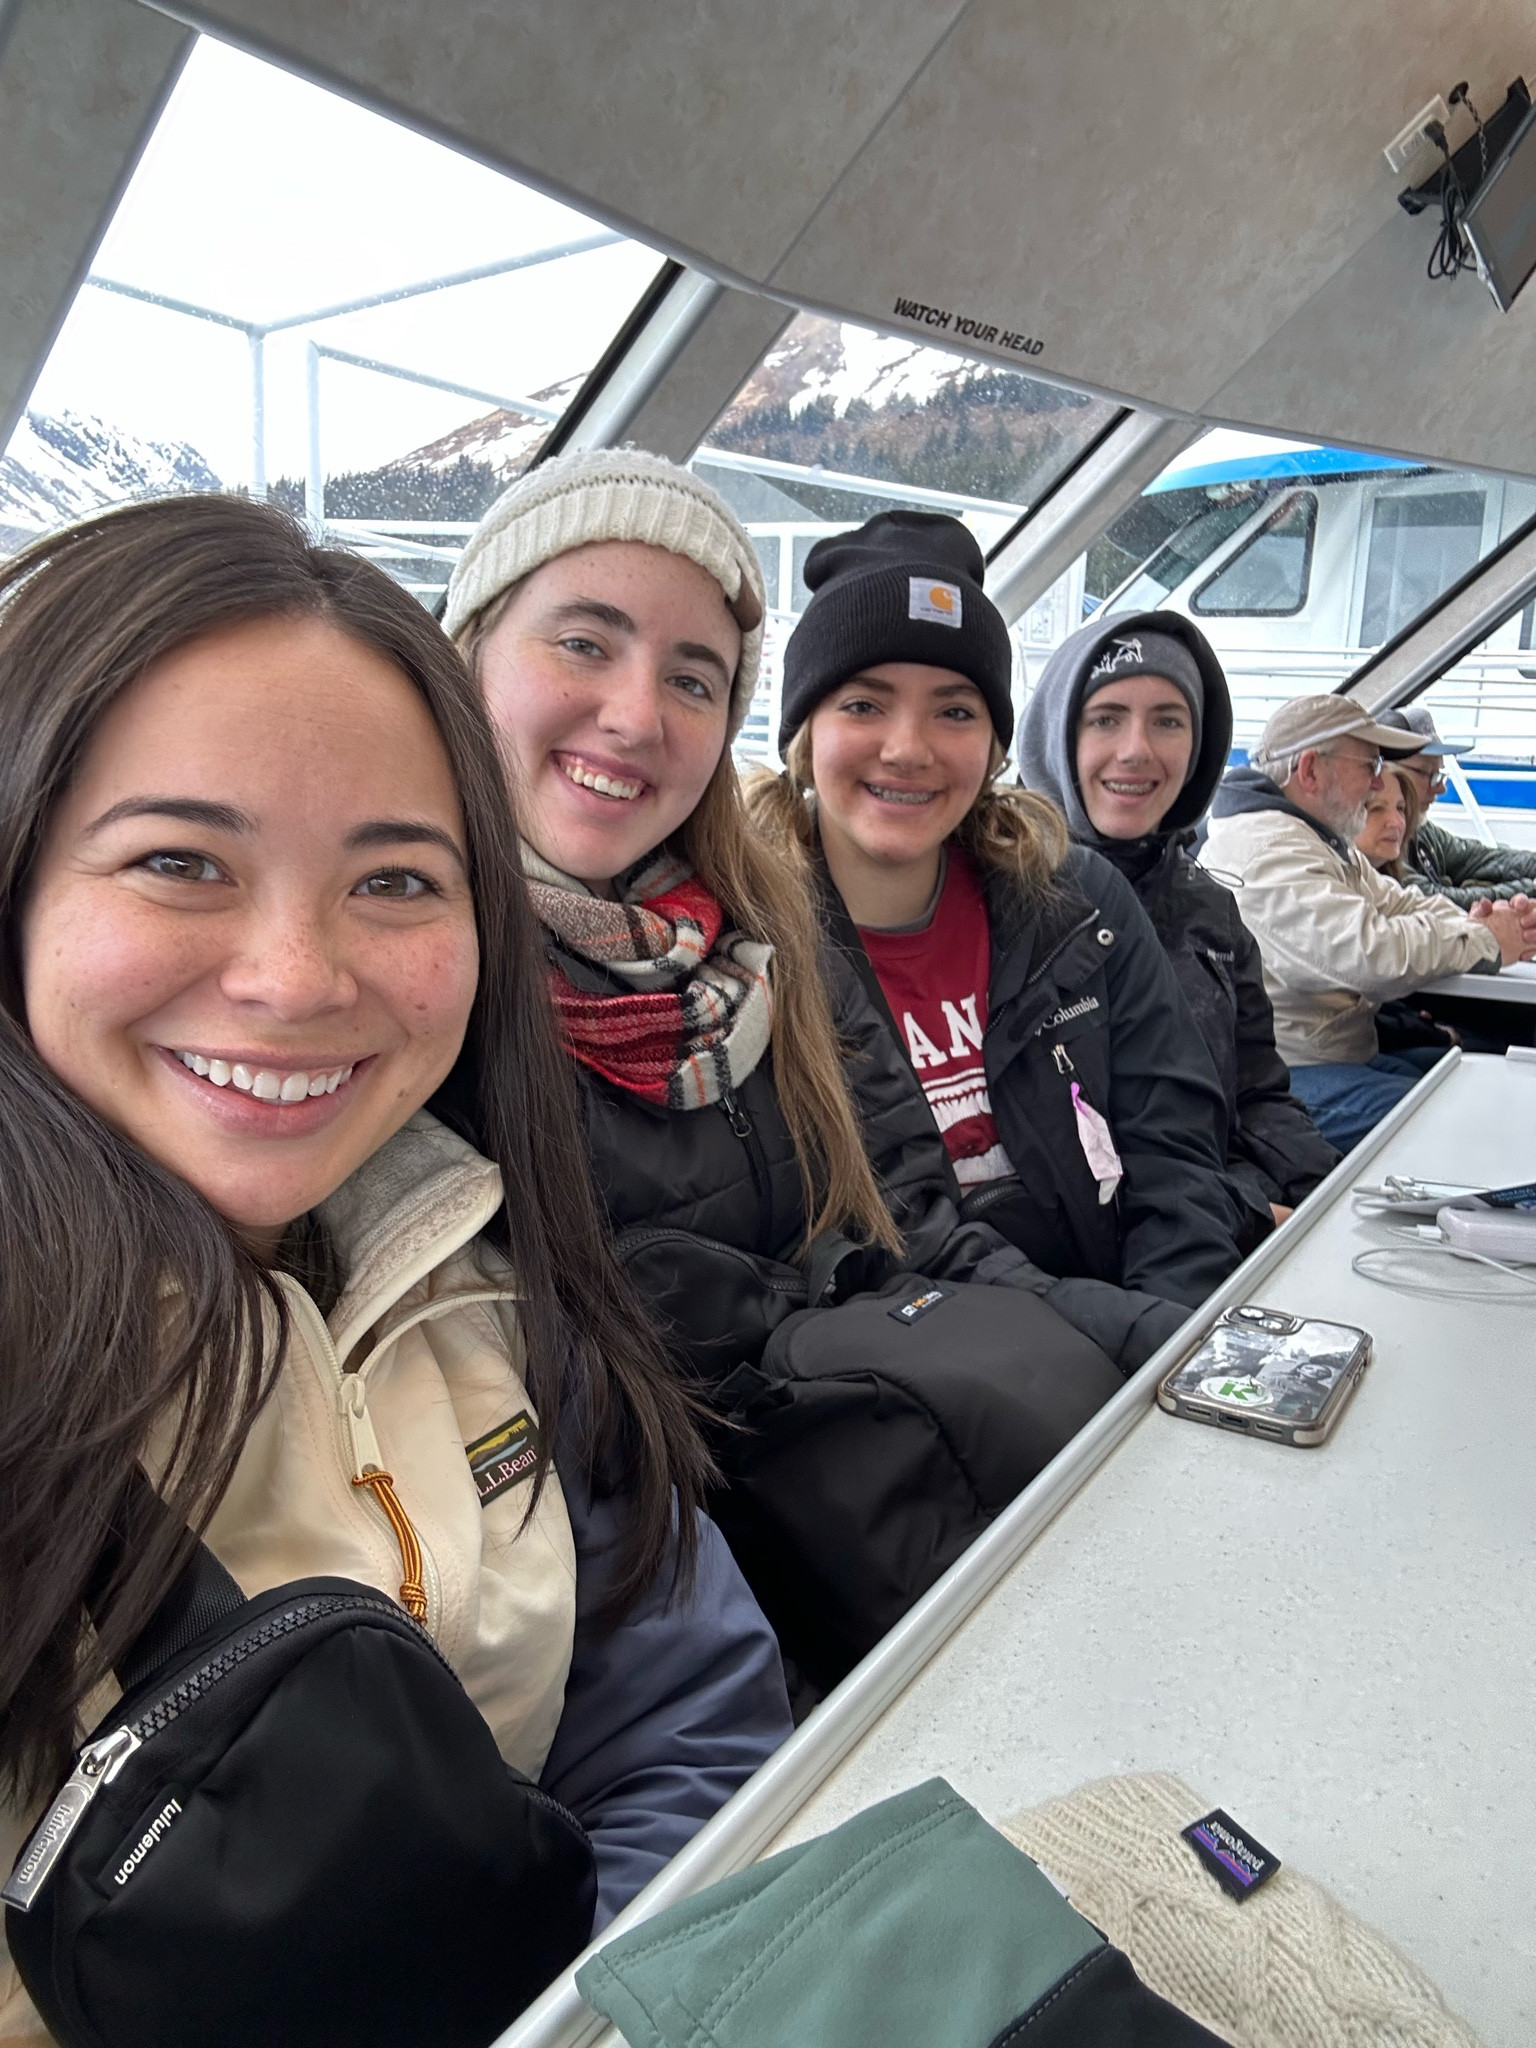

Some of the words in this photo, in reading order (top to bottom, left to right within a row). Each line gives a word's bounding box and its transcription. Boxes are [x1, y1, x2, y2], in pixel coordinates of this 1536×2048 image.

[894, 297, 952, 329] WATCH
[953, 315, 999, 344] YOUR
[999, 330, 1045, 357] HEAD
[902, 993, 990, 1069] AN
[1042, 995, 1099, 1029] Columbia
[18, 1803, 73, 1884] lululemon
[114, 1798, 183, 1885] lululemon
[1209, 1820, 1266, 1872] patagonia
